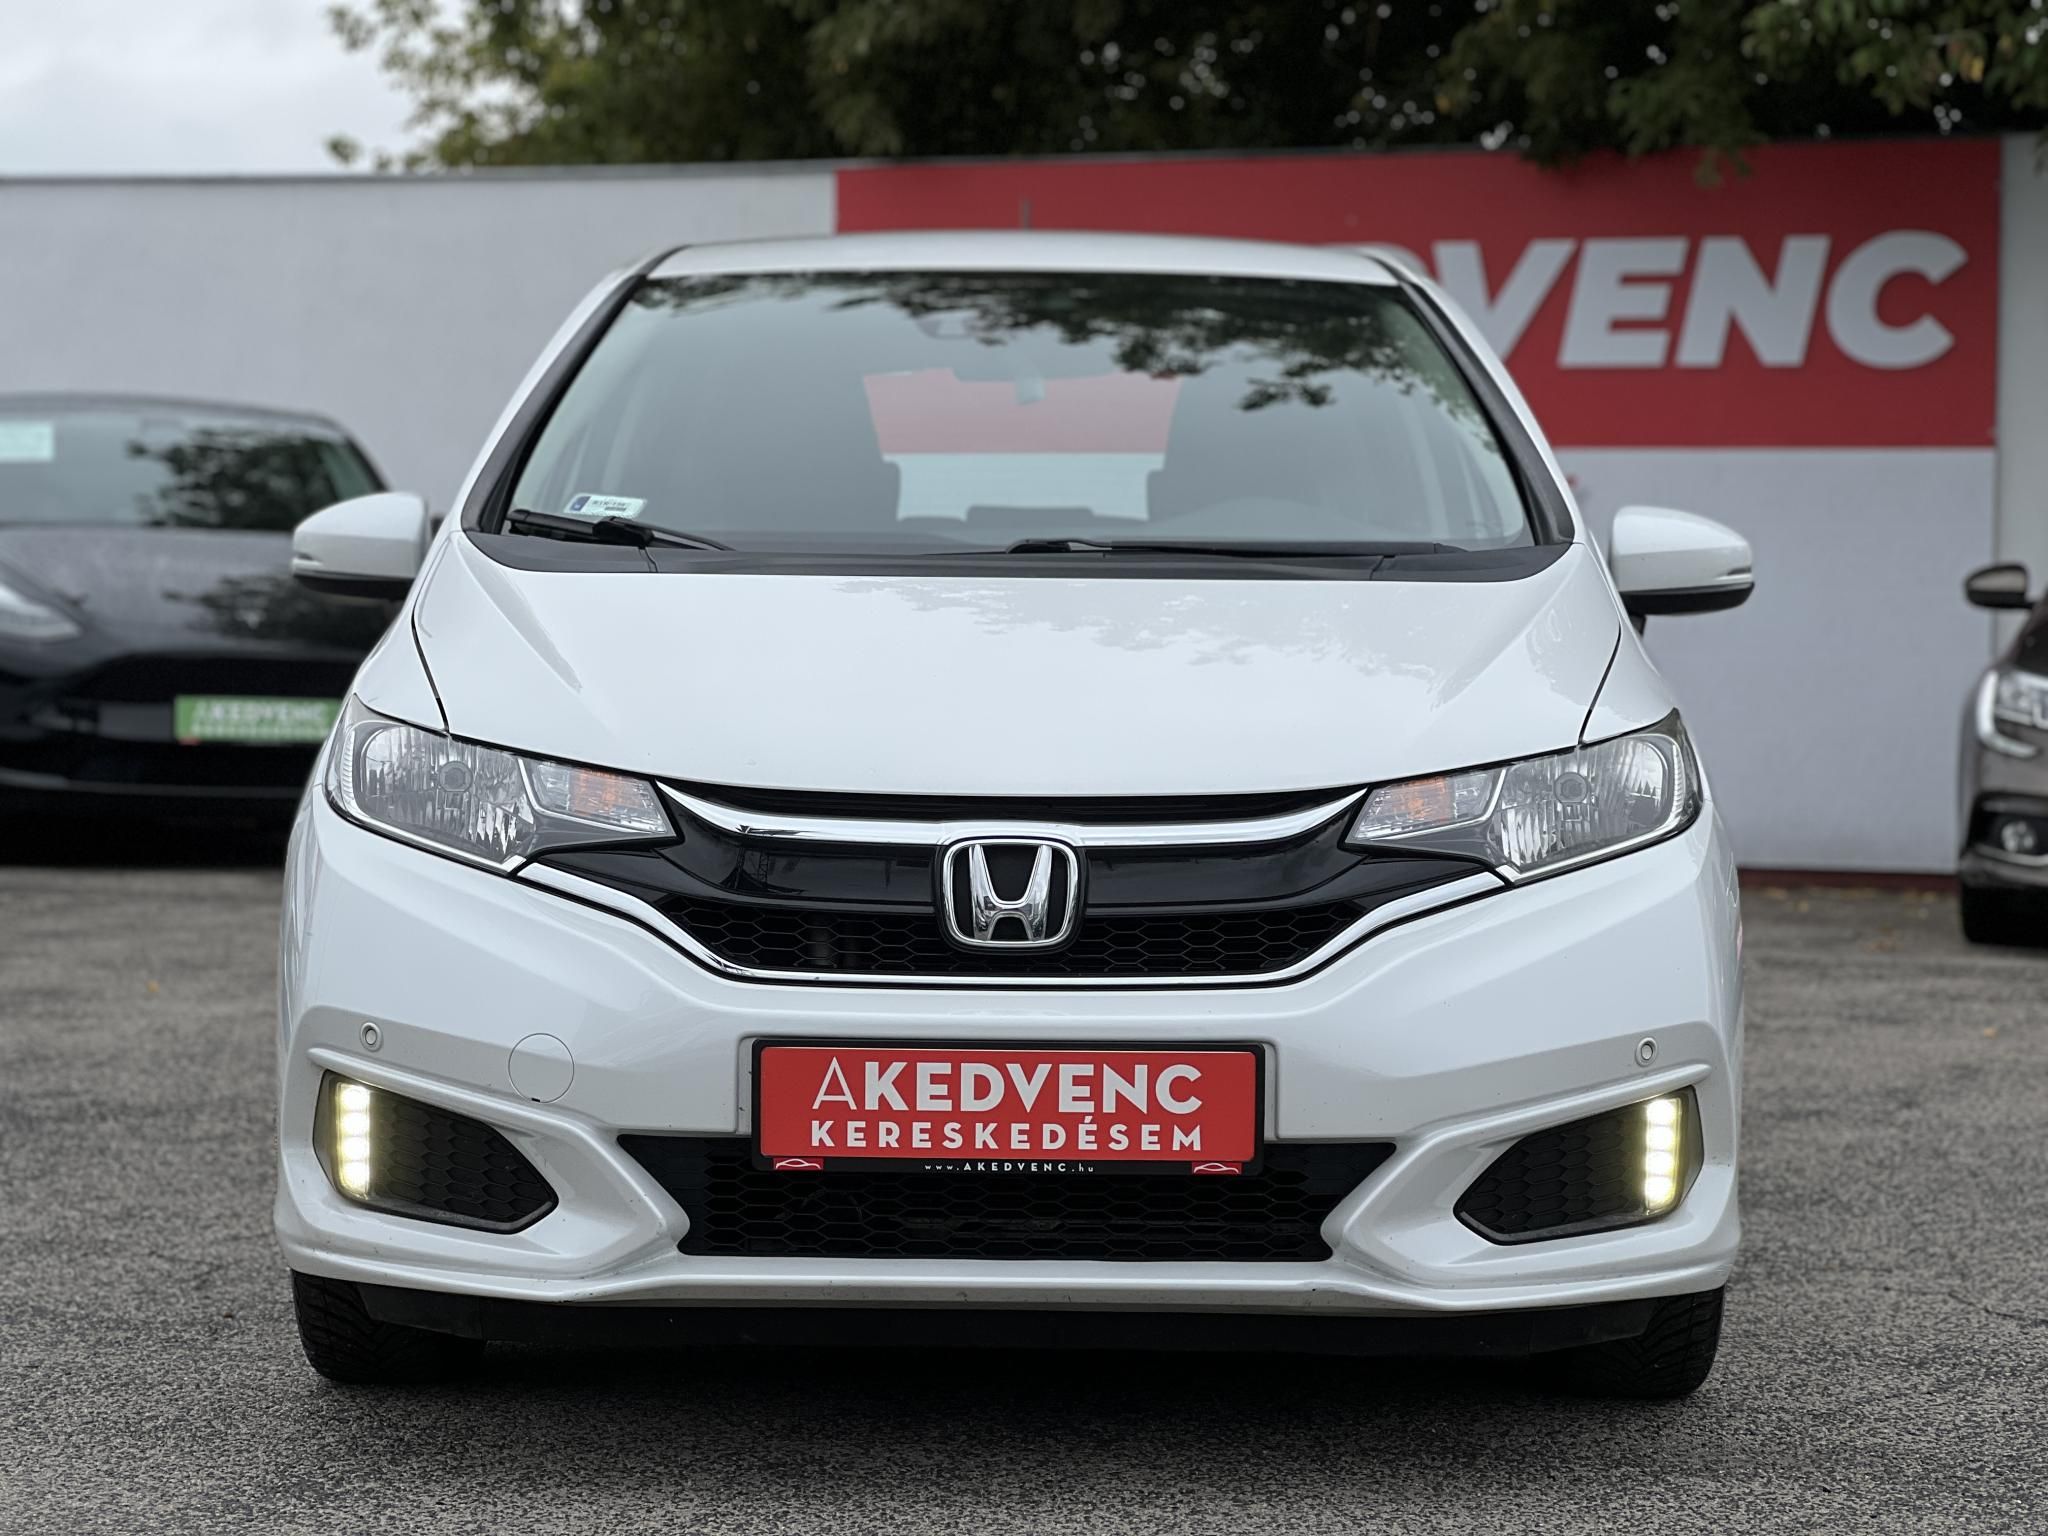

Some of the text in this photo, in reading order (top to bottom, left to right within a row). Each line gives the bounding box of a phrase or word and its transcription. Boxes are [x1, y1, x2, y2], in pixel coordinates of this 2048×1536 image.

[1325, 230, 1969, 370] VENC
[811, 1056, 1203, 1115] AKEDVENC
[811, 1116, 1202, 1152] KERESKEDÉSEM
[924, 1161, 1094, 1173] www.AKEDVENC.hu
